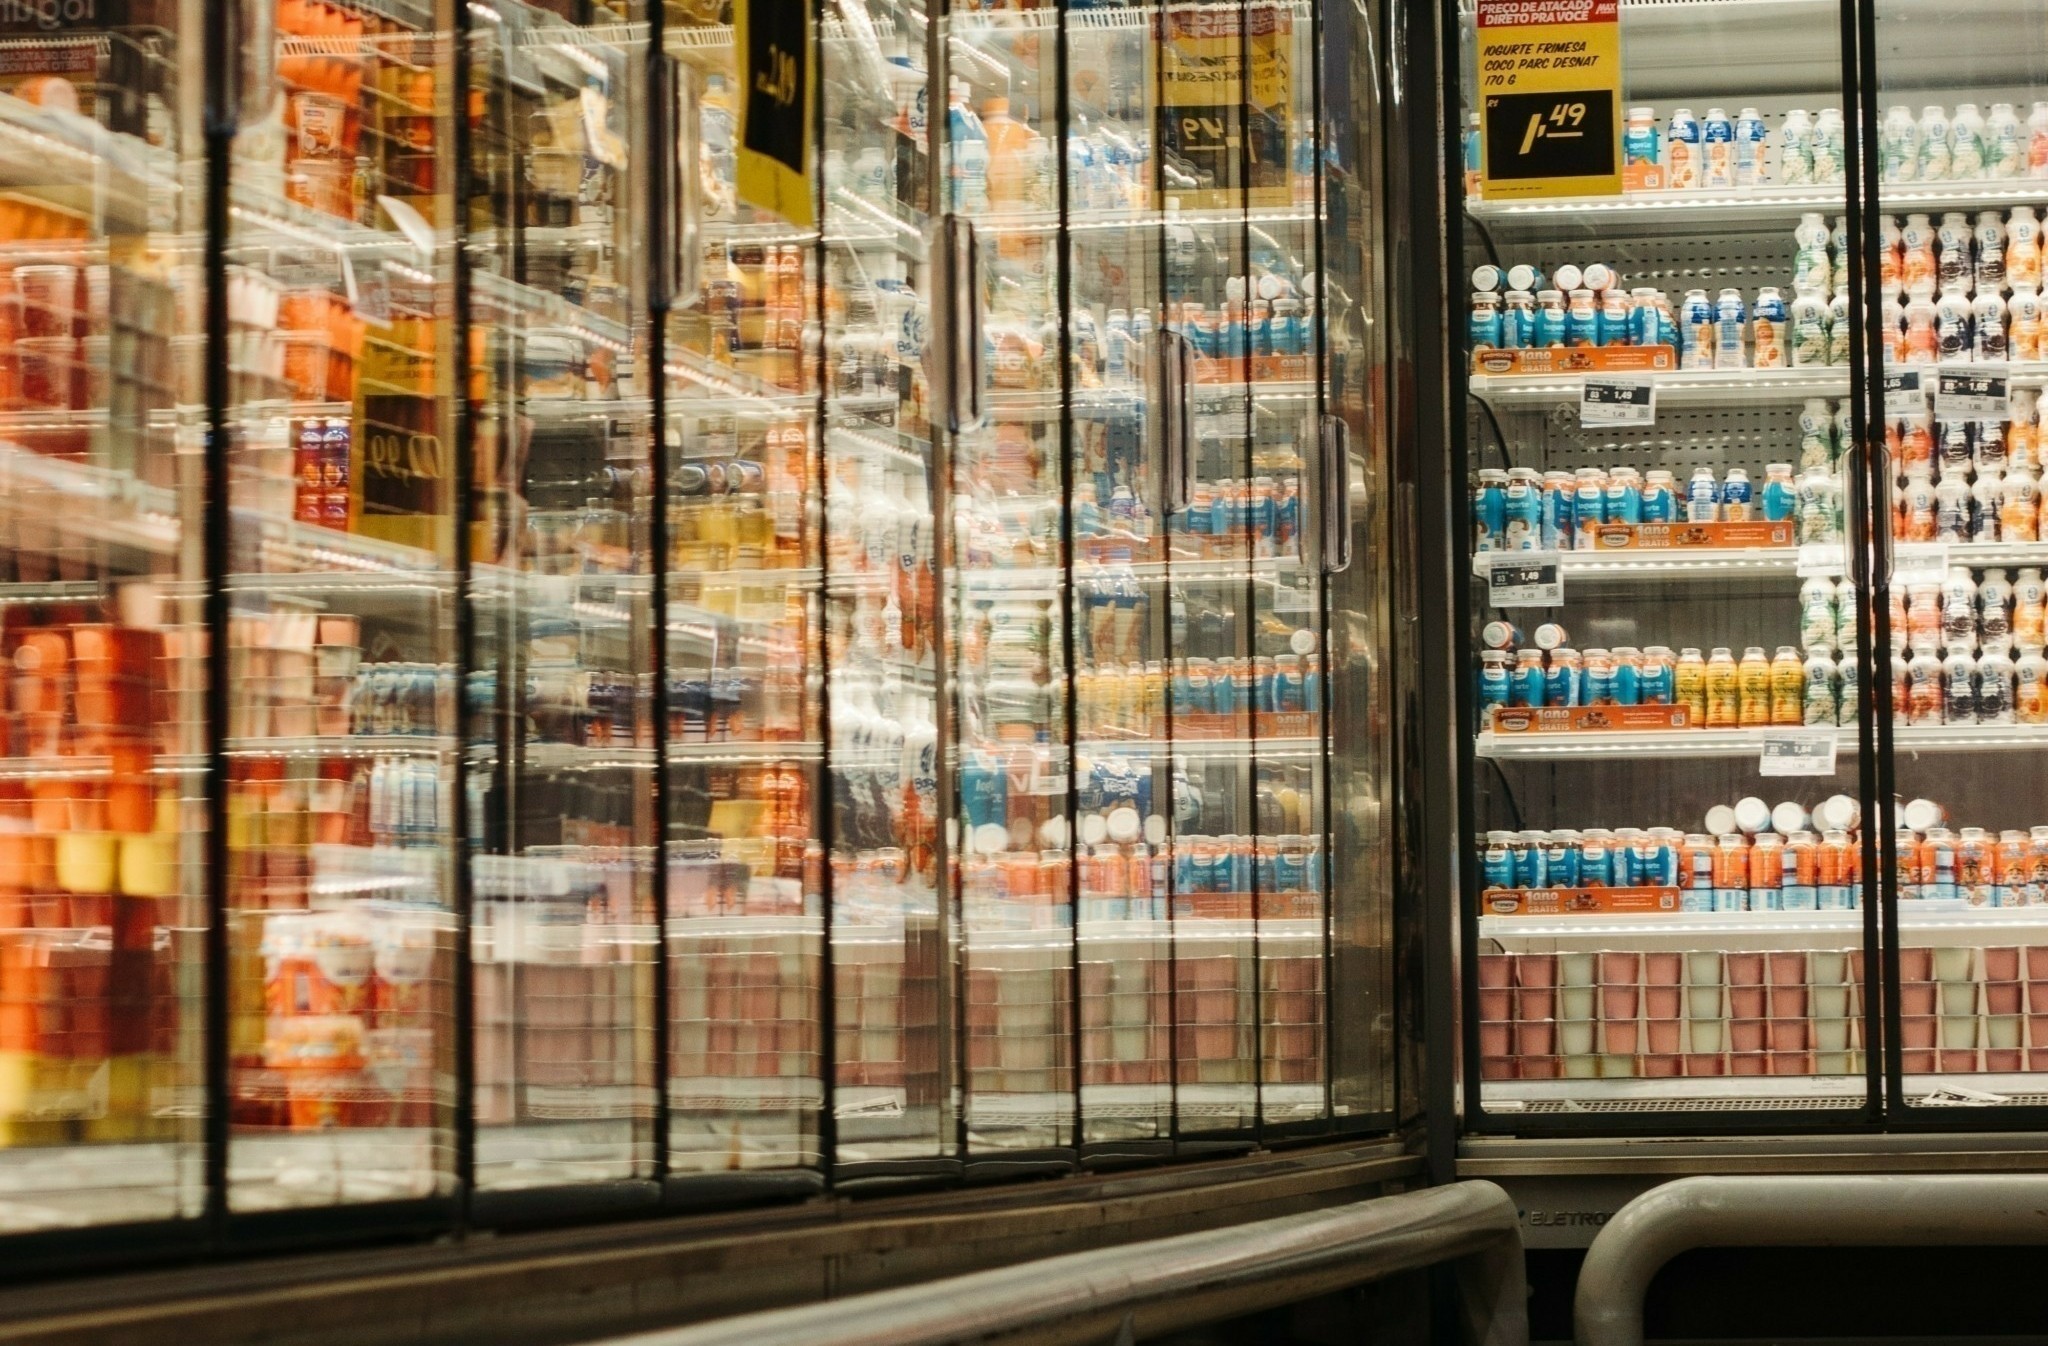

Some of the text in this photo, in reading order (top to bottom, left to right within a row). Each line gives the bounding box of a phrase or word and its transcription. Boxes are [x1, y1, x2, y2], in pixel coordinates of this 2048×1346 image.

[1521, 2, 1537, 12] DE
[1538, 0, 1595, 11] ATACADO
[1485, 13, 1529, 25] DIRETO
[1530, 11, 1555, 23] PRA
[1484, 41, 1587, 56] IOGURTE FRIMESA
[1485, 55, 1600, 71] COCO PARC DESNAT
[1485, 74, 1517, 86] 170 G
